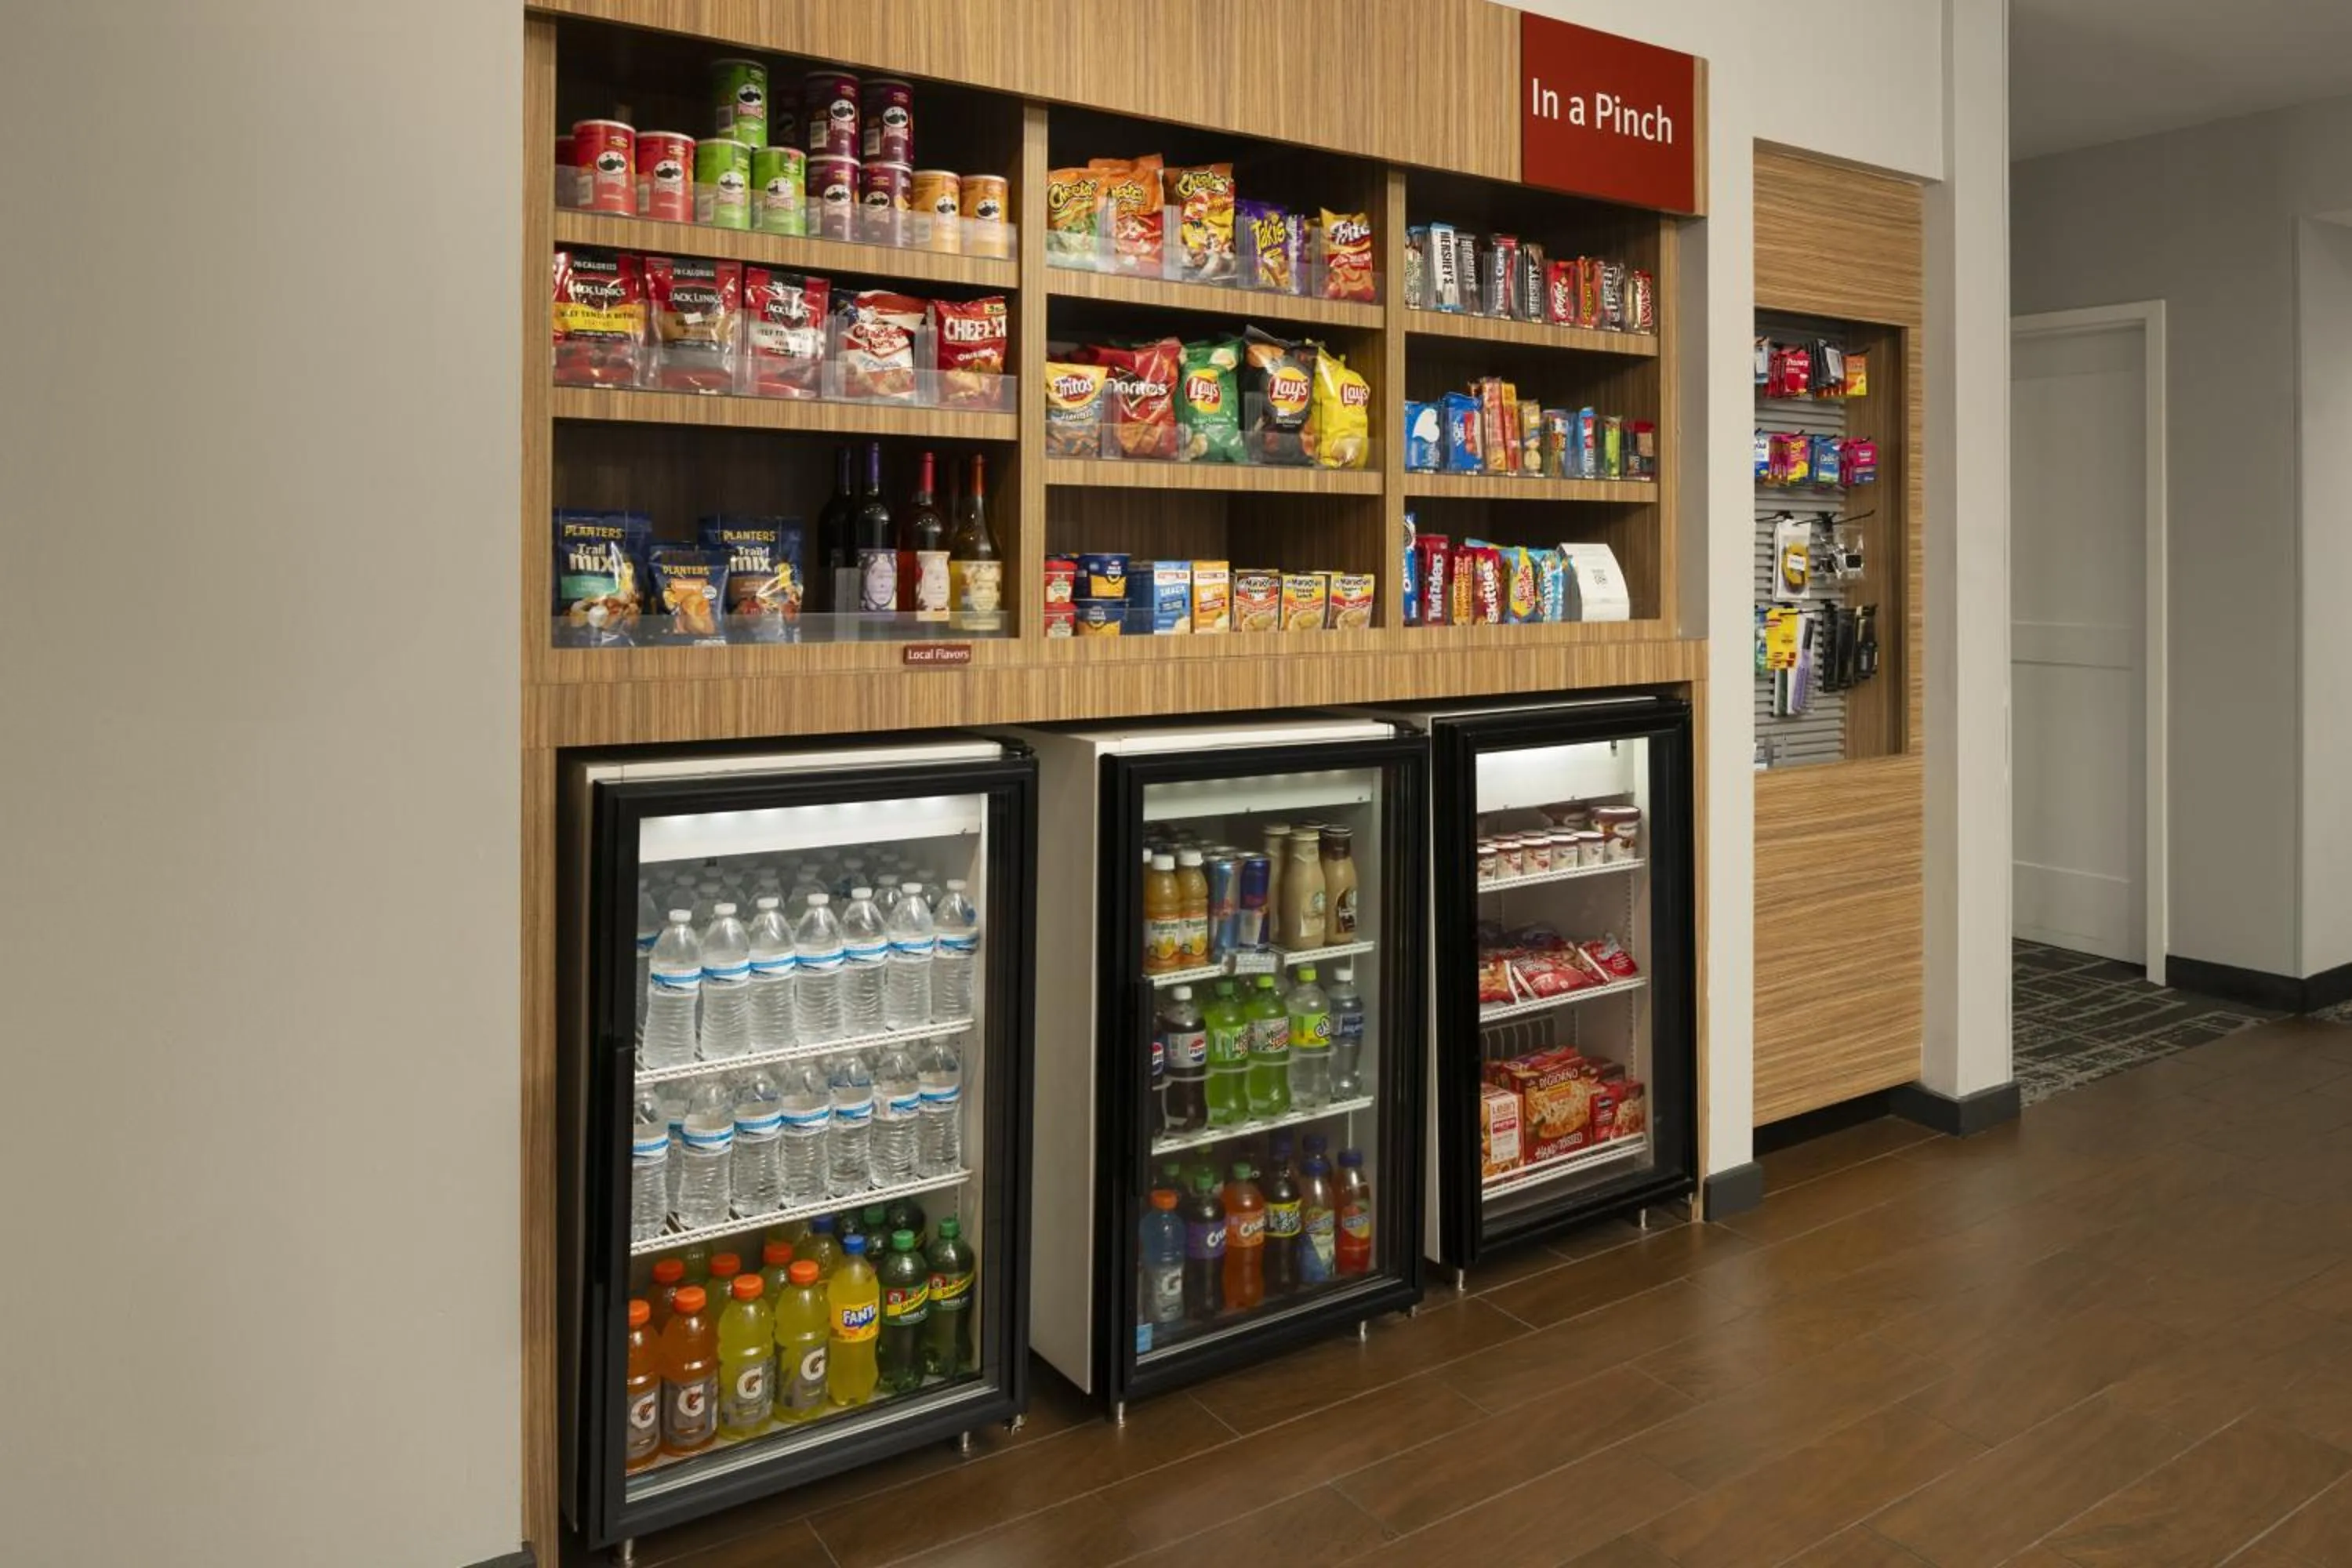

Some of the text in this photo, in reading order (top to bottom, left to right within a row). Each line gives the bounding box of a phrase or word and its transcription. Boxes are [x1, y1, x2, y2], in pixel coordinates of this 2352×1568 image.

[1533, 78, 1672, 144] In a Pinch
[1250, 218, 1286, 255] Takis
[564, 524, 625, 539] PLANTERS
[723, 530, 775, 542] PLANTERS
[577, 543, 606, 555] Trail
[568, 553, 616, 573] mix
[662, 565, 710, 575] PLANTERS
[730, 555, 772, 572] mix
[909, 648, 969, 660] Local Flavors
[800, 1347, 826, 1381] G
[737, 1367, 763, 1399] G
[630, 1392, 655, 1428] G
[678, 1384, 705, 1417] G
